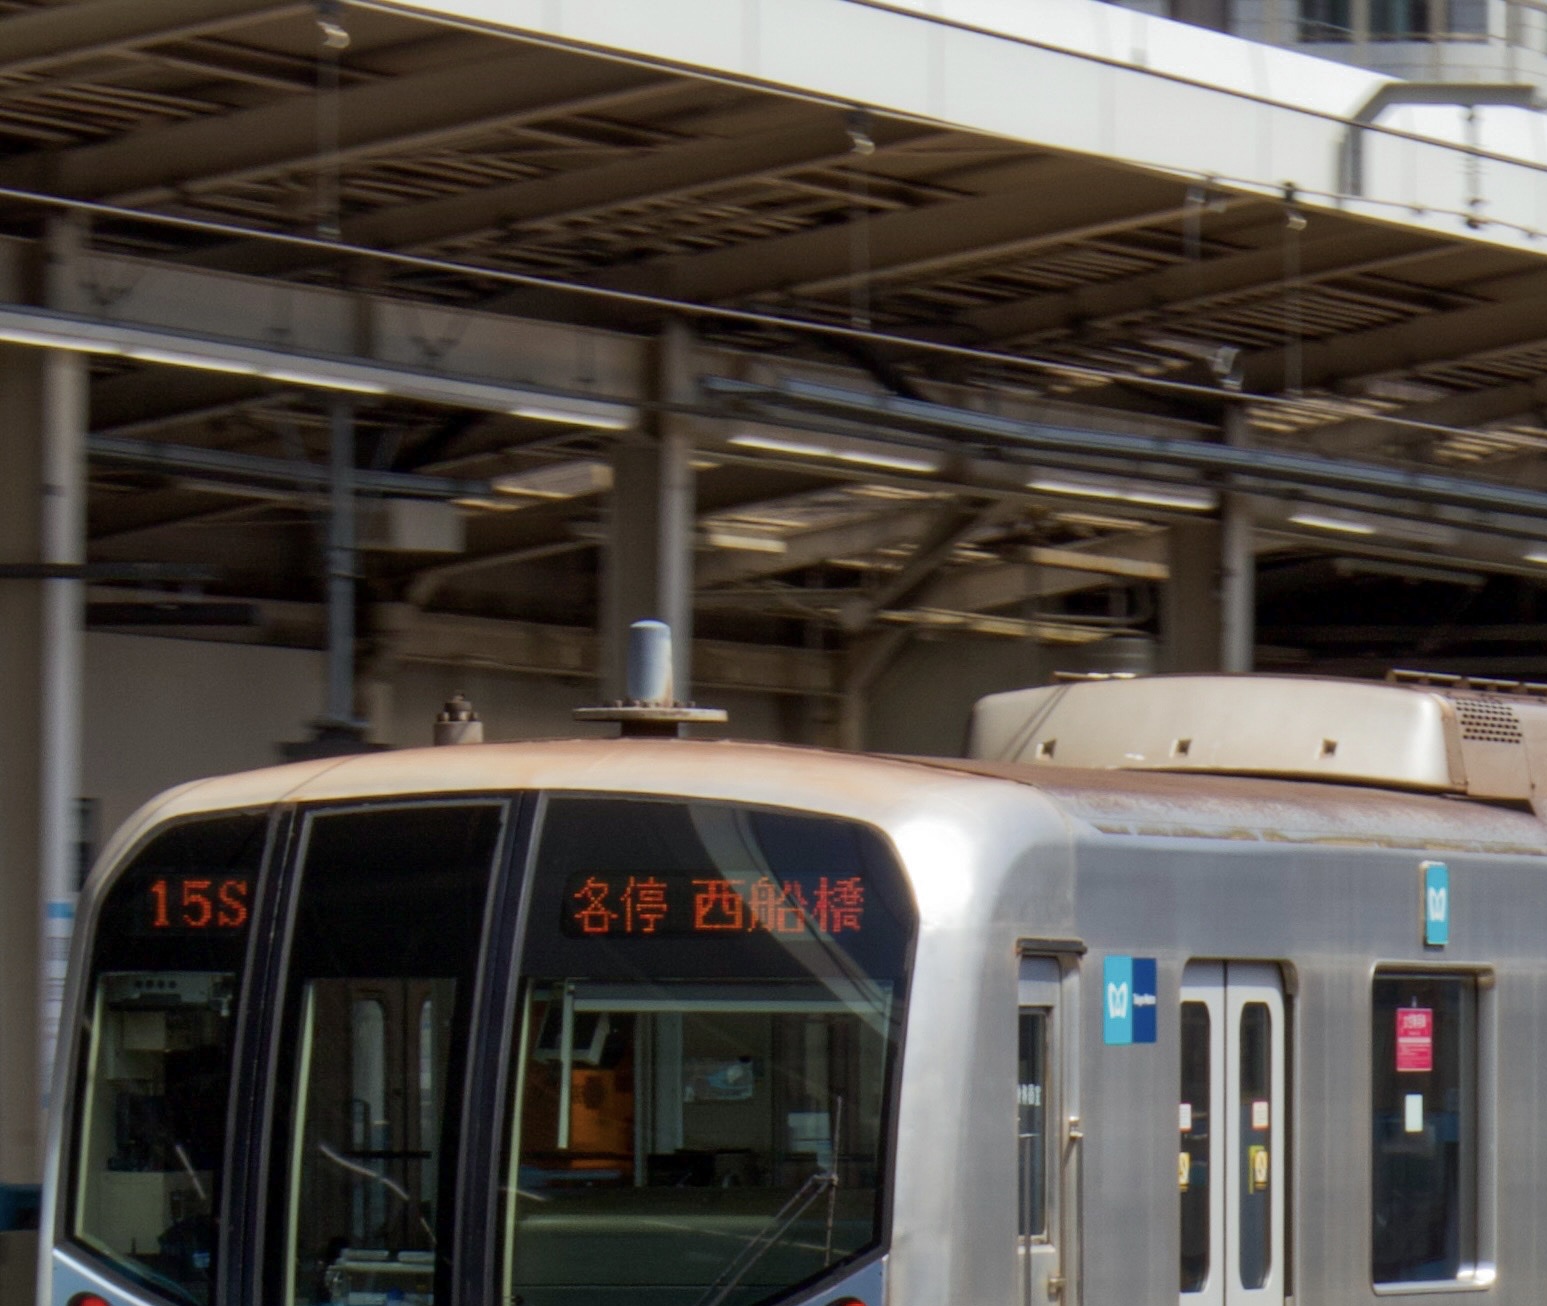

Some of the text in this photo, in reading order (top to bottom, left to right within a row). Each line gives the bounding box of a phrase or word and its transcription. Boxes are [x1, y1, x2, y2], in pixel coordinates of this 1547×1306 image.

[150, 879, 248, 928] 15S
[574, 876, 864, 933] 各停 西船橋
